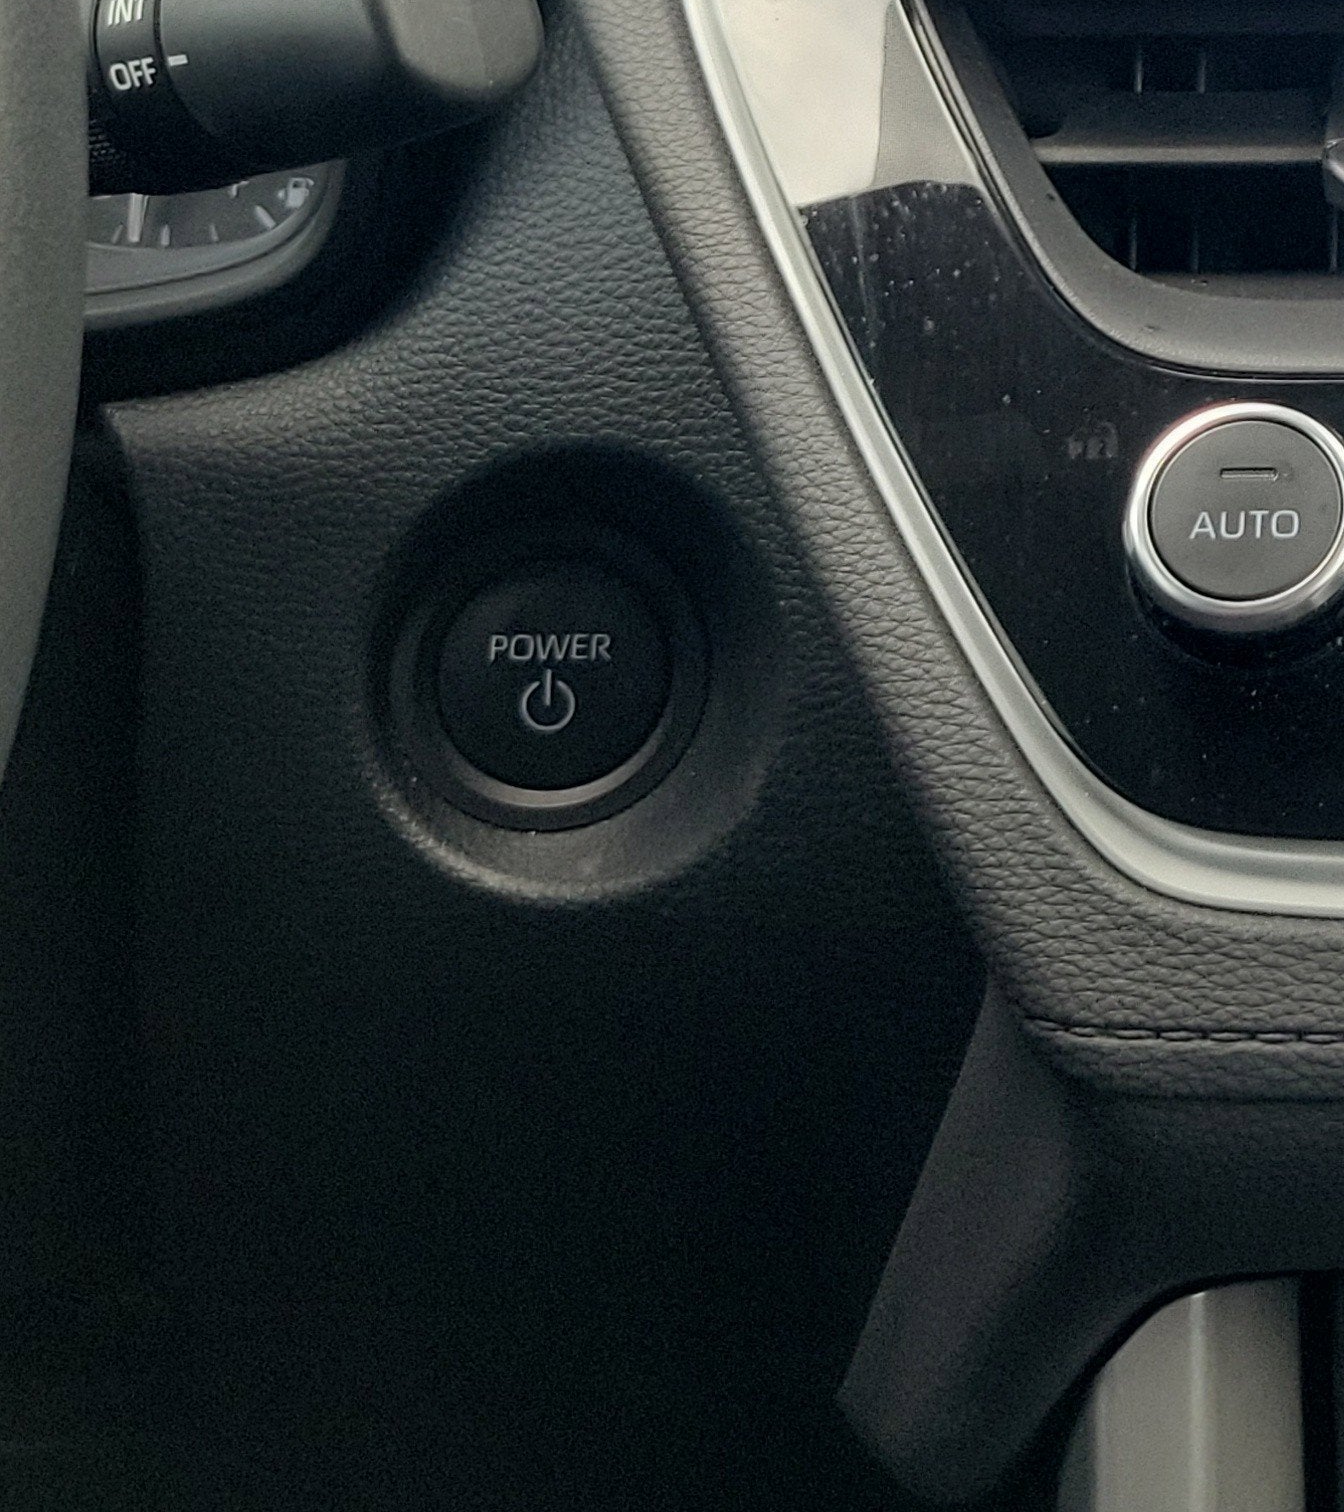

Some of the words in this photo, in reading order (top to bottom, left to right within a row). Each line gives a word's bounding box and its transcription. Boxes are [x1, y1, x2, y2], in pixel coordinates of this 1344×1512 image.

[109, 57, 157, 91] OFF
[1188, 508, 1300, 540] AUTO
[488, 633, 612, 662] POWER
